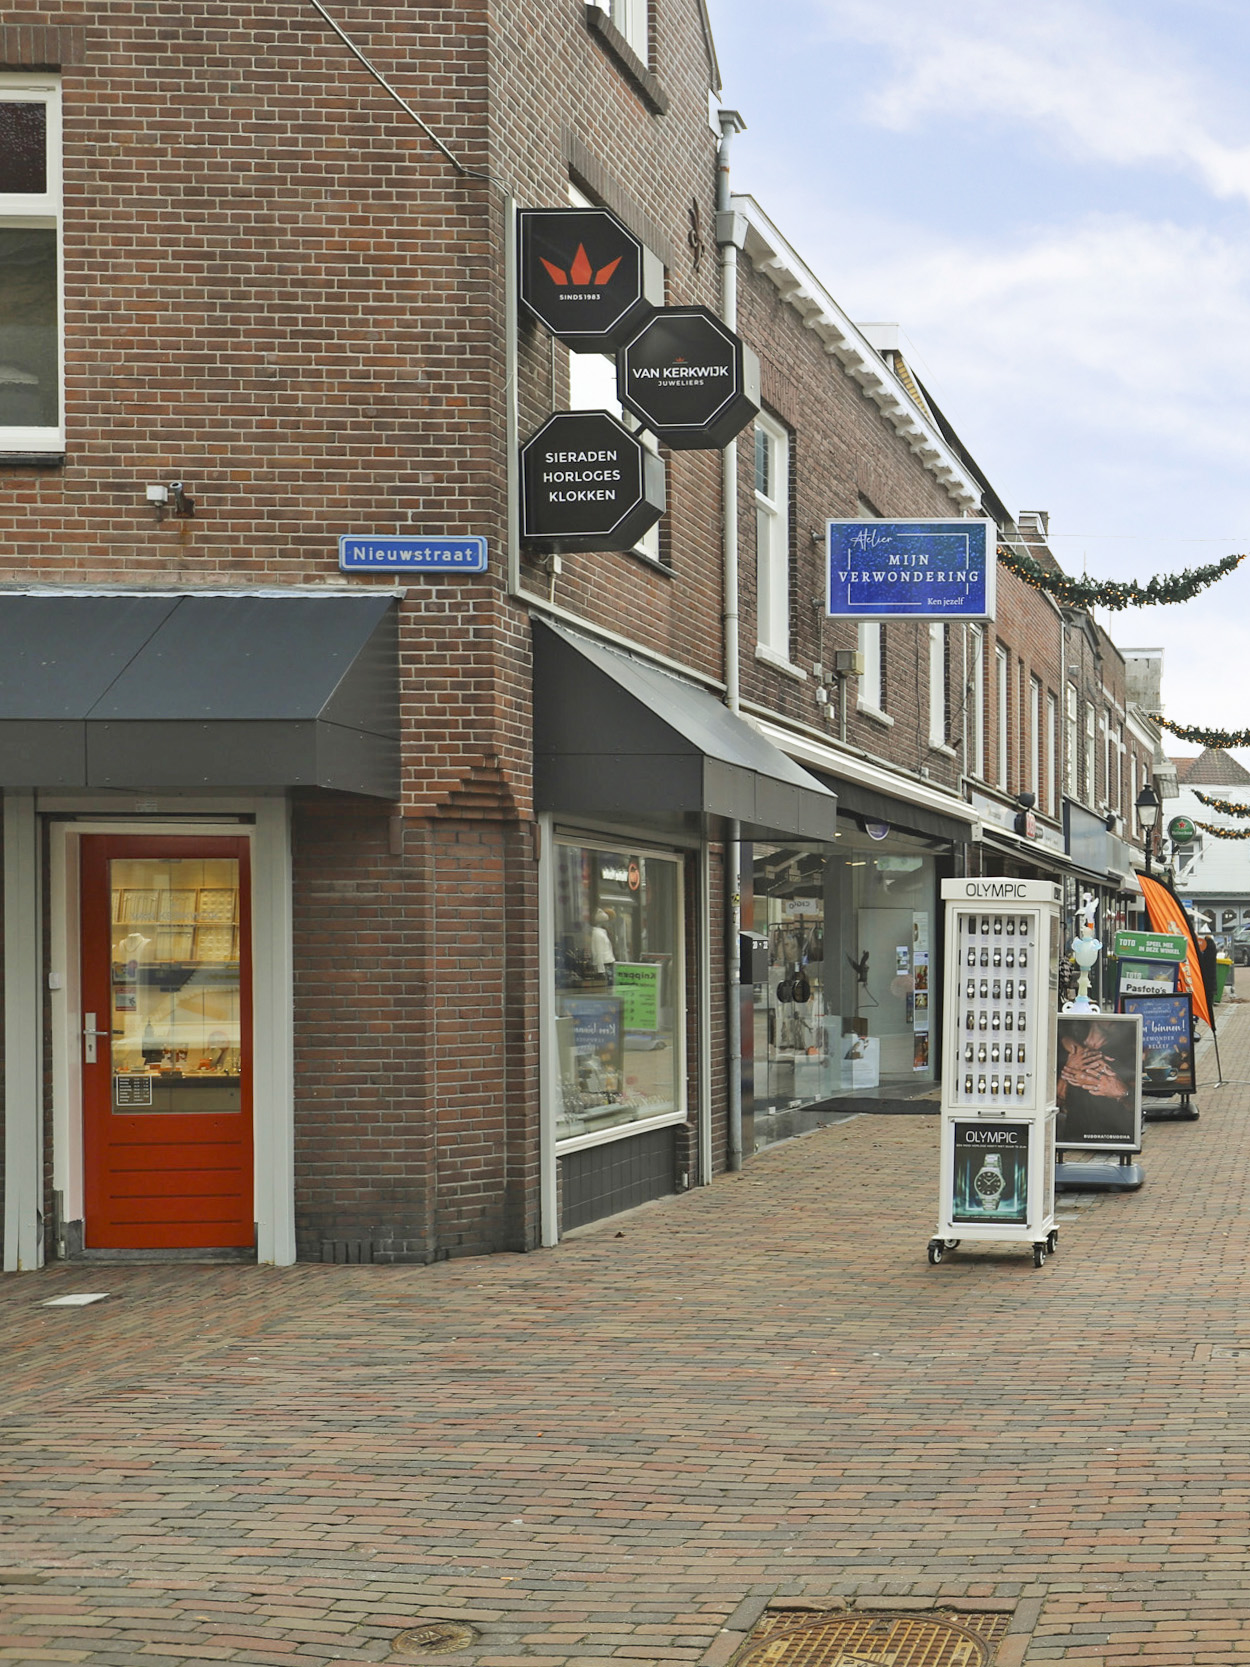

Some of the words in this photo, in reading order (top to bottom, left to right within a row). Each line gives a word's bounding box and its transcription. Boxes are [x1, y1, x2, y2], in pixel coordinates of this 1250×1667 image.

[632, 367, 660, 379] VAN
[663, 365, 729, 378] KERKWIJK
[658, 379, 704, 387] JUWELIERS
[545, 450, 617, 463] SIERADEN
[543, 469, 621, 483] HORLOGES
[549, 489, 616, 503] KLOKKEN
[850, 528, 893, 551] Atelier
[353, 546, 473, 561] Nieuwstraat
[888, 554, 930, 567] MIJN
[838, 570, 979, 582] VERWONDERING
[928, 597, 942, 606] Ken
[942, 597, 964, 607] jezelf
[966, 882, 1027, 898] OLYMPIC
[1119, 938, 1136, 946] TOTO
[1126, 984, 1166, 994] Pasfoto's
[1152, 1020, 1186, 1033] binnen!
[965, 1130, 1018, 1144] OLYMPIC
